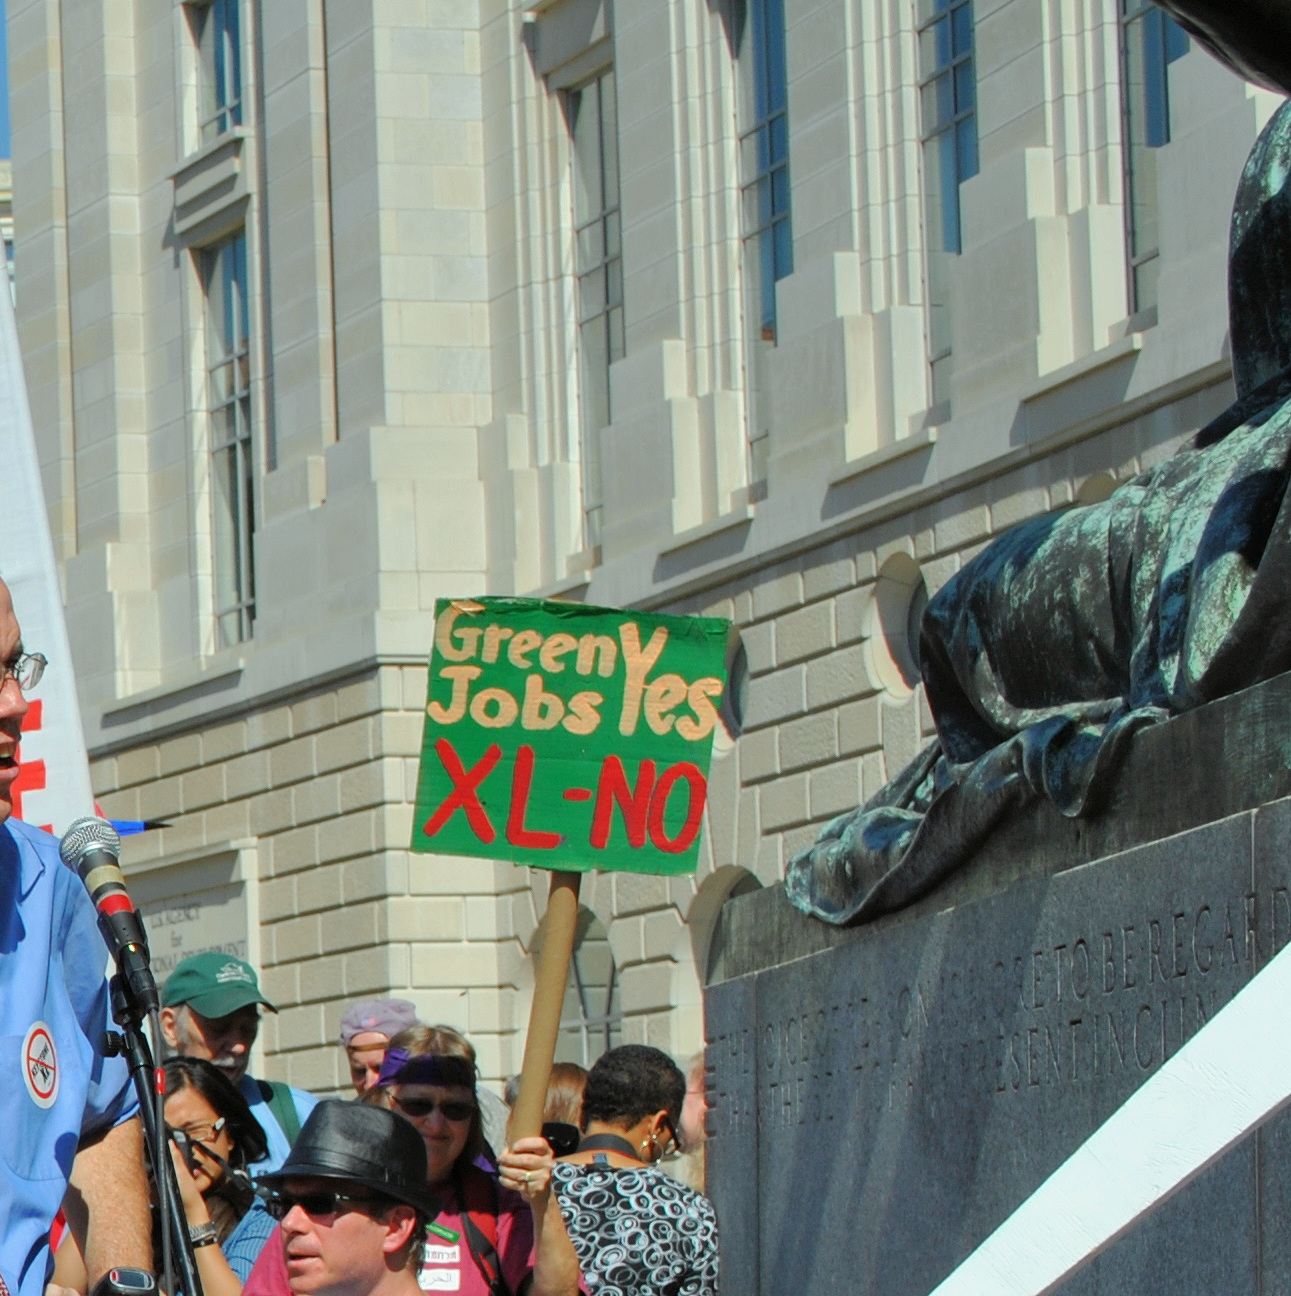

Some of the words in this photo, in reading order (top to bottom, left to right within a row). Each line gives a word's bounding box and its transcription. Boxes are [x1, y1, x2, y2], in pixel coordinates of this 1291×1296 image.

[426, 665, 604, 735] Jobs
[435, 600, 618, 677] Green
[619, 621, 723, 741] Yes
[423, 738, 707, 853] XL-NO
[1103, 925, 1136, 995] BE
